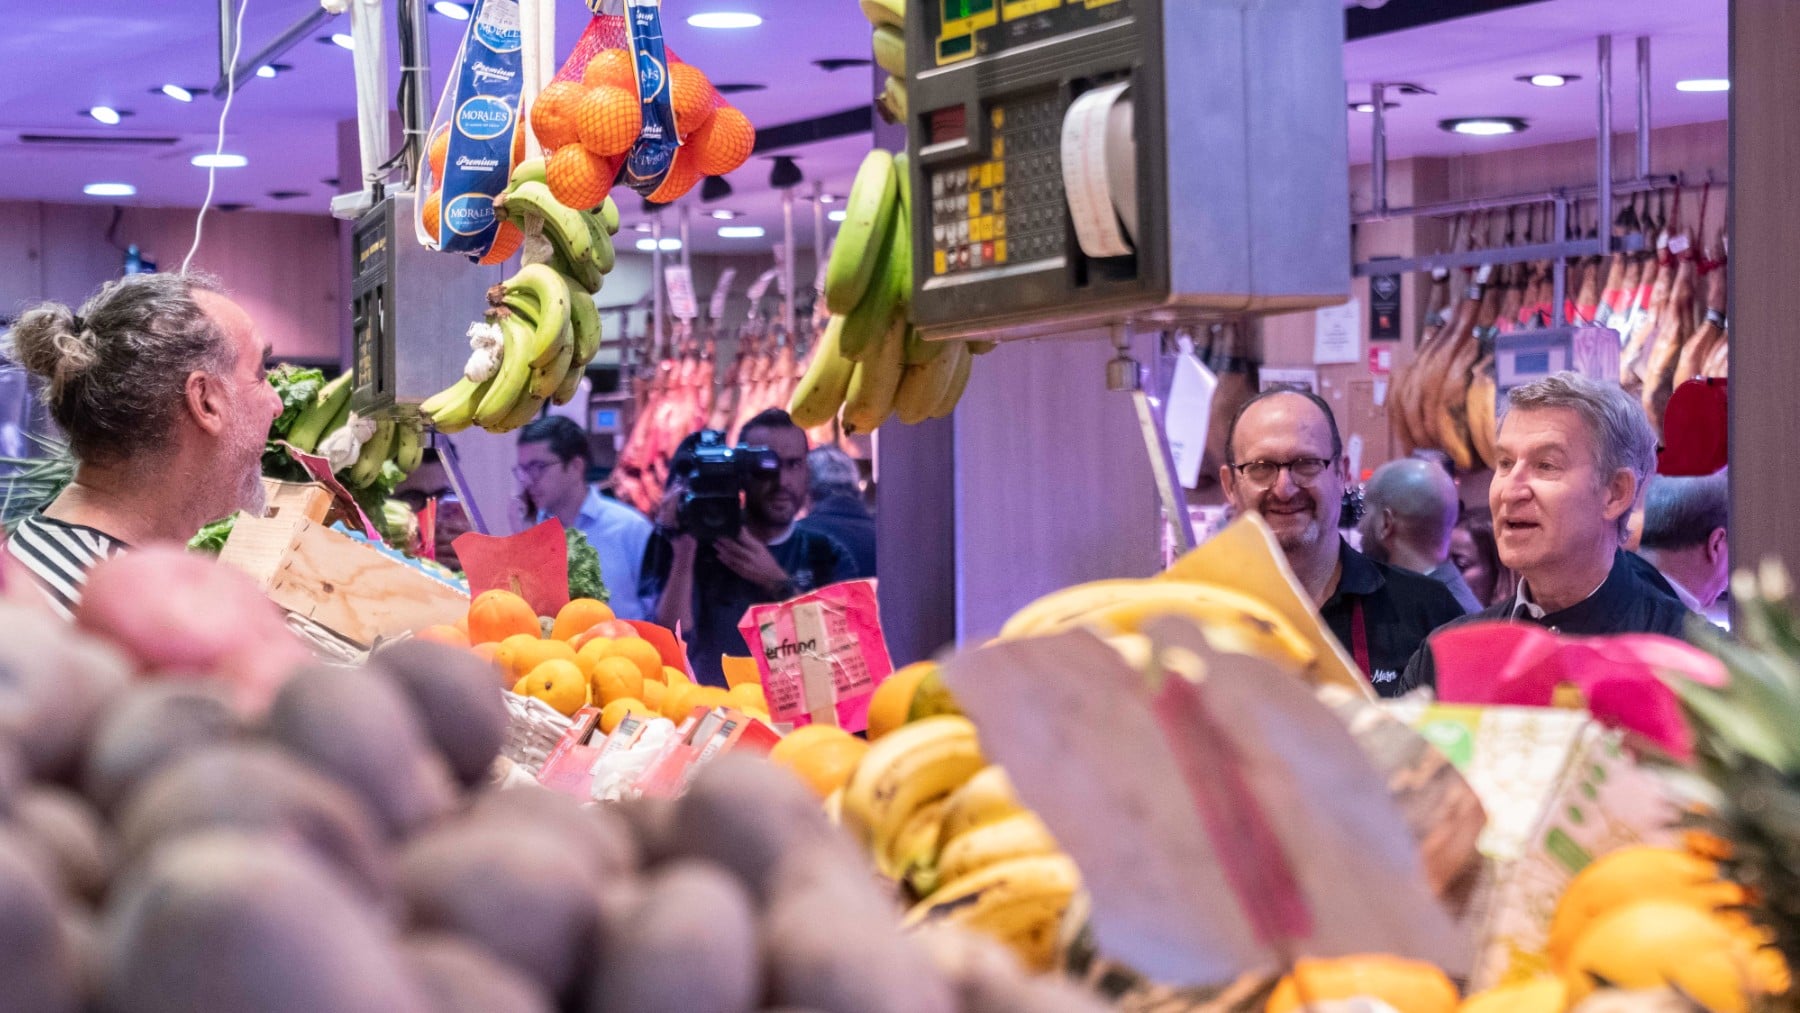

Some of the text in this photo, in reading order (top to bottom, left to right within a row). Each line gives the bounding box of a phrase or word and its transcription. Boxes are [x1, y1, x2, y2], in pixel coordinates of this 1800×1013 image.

[472, 61, 516, 78] Premium
[461, 110, 508, 122] MORALES
[456, 155, 499, 167] Premium
